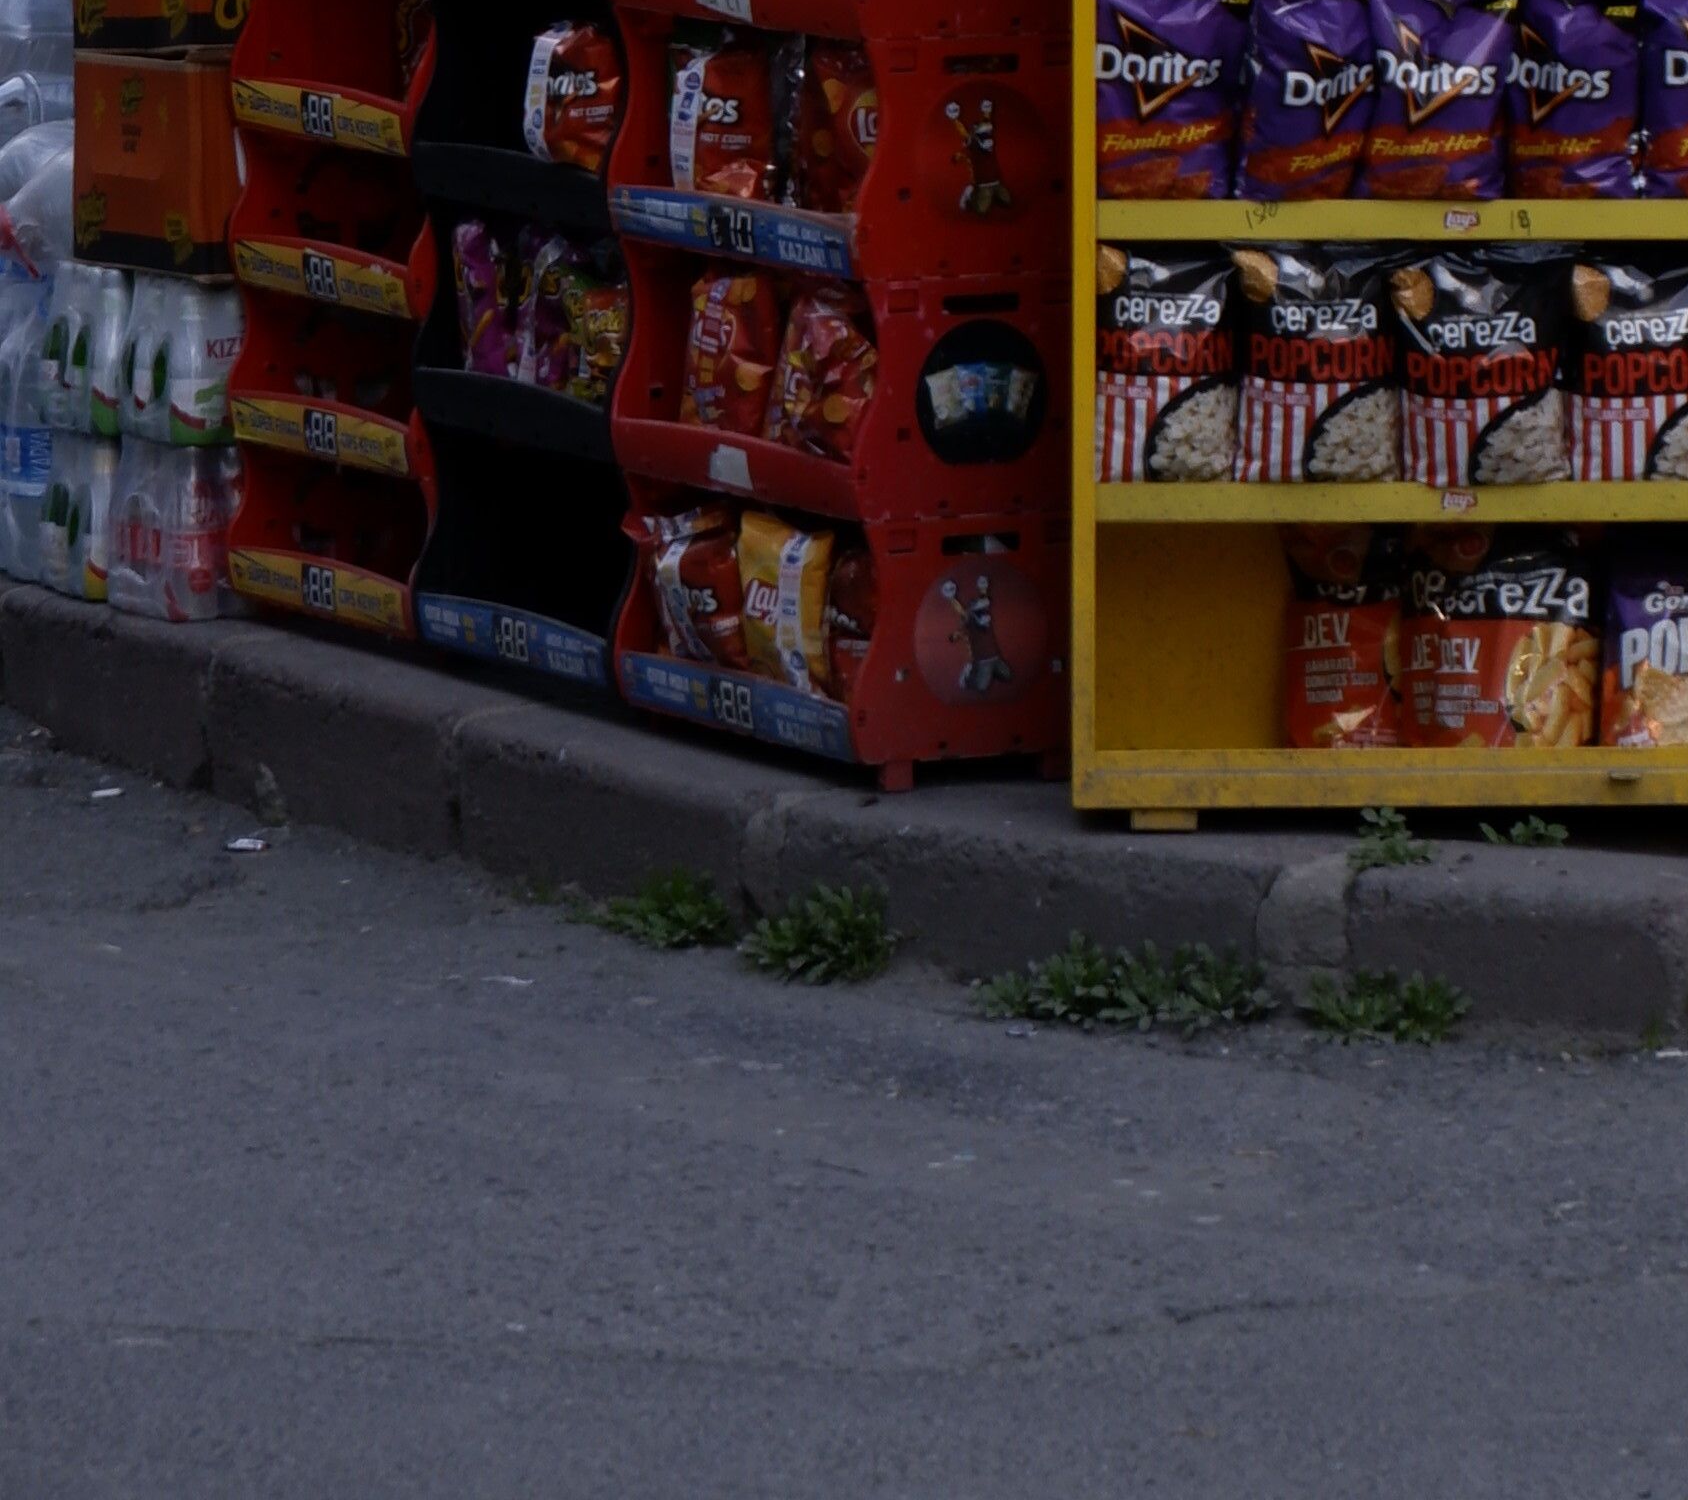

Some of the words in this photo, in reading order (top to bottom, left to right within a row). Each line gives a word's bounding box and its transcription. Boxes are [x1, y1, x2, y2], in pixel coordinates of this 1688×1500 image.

[1096, 42, 1222, 87] Doritos
[1175, 124, 1216, 147] Hot
[1444, 132, 1488, 154] Hot
[778, 239, 828, 269] KAZAN!
[1249, 332, 1397, 381] POPCORN
[1405, 348, 1560, 397] POPCORN
[1303, 612, 1352, 648] DEV
[1440, 636, 1482, 673] DEV
